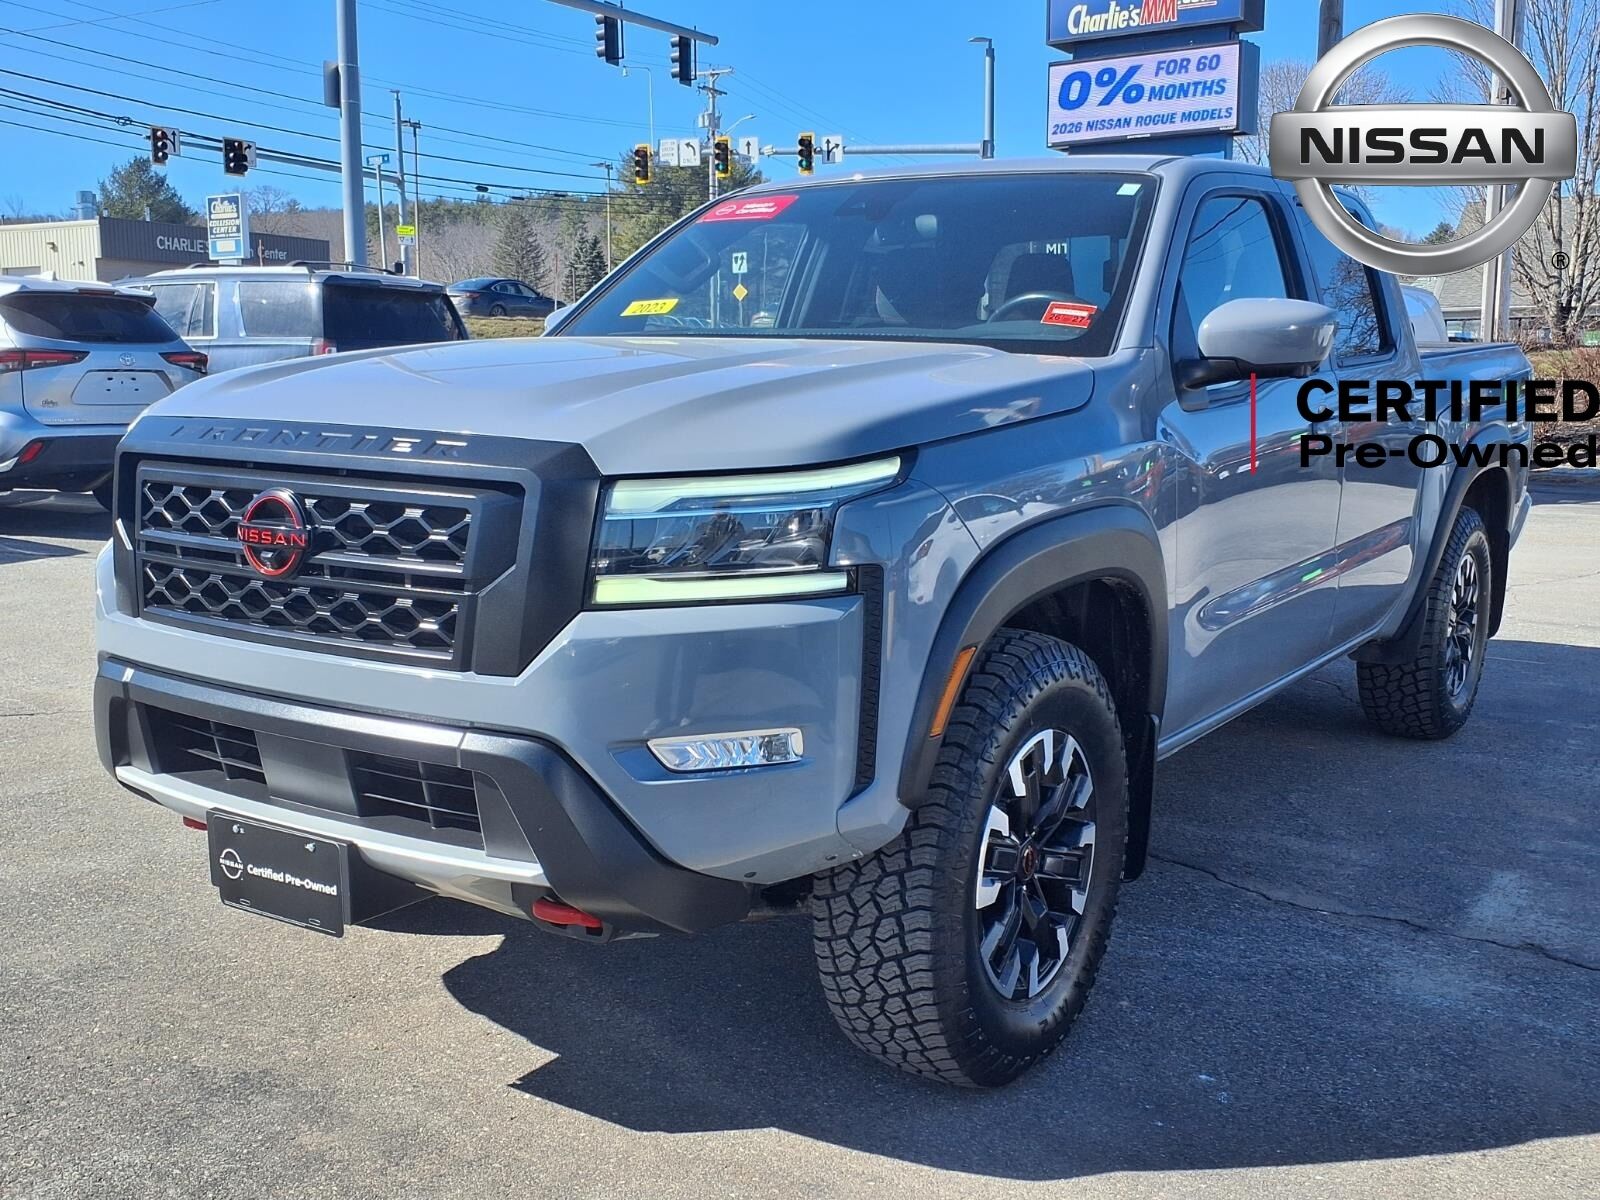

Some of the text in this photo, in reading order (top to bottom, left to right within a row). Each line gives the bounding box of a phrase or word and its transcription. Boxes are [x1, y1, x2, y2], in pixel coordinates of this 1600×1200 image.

[1155, 54, 1221, 77] FOR 60
[1058, 64, 1145, 111] 0%
[1147, 78, 1227, 102] MONTHS
[1051, 107, 1233, 135] 2026 NISSAN ROGUE MODELS
[634, 300, 666, 313] 2023
[170, 425, 468, 457] FRONTIER
[237, 525, 305, 547] NISSAN
[247, 864, 284, 883] Certified
[285, 873, 338, 896] Pre-Owned
